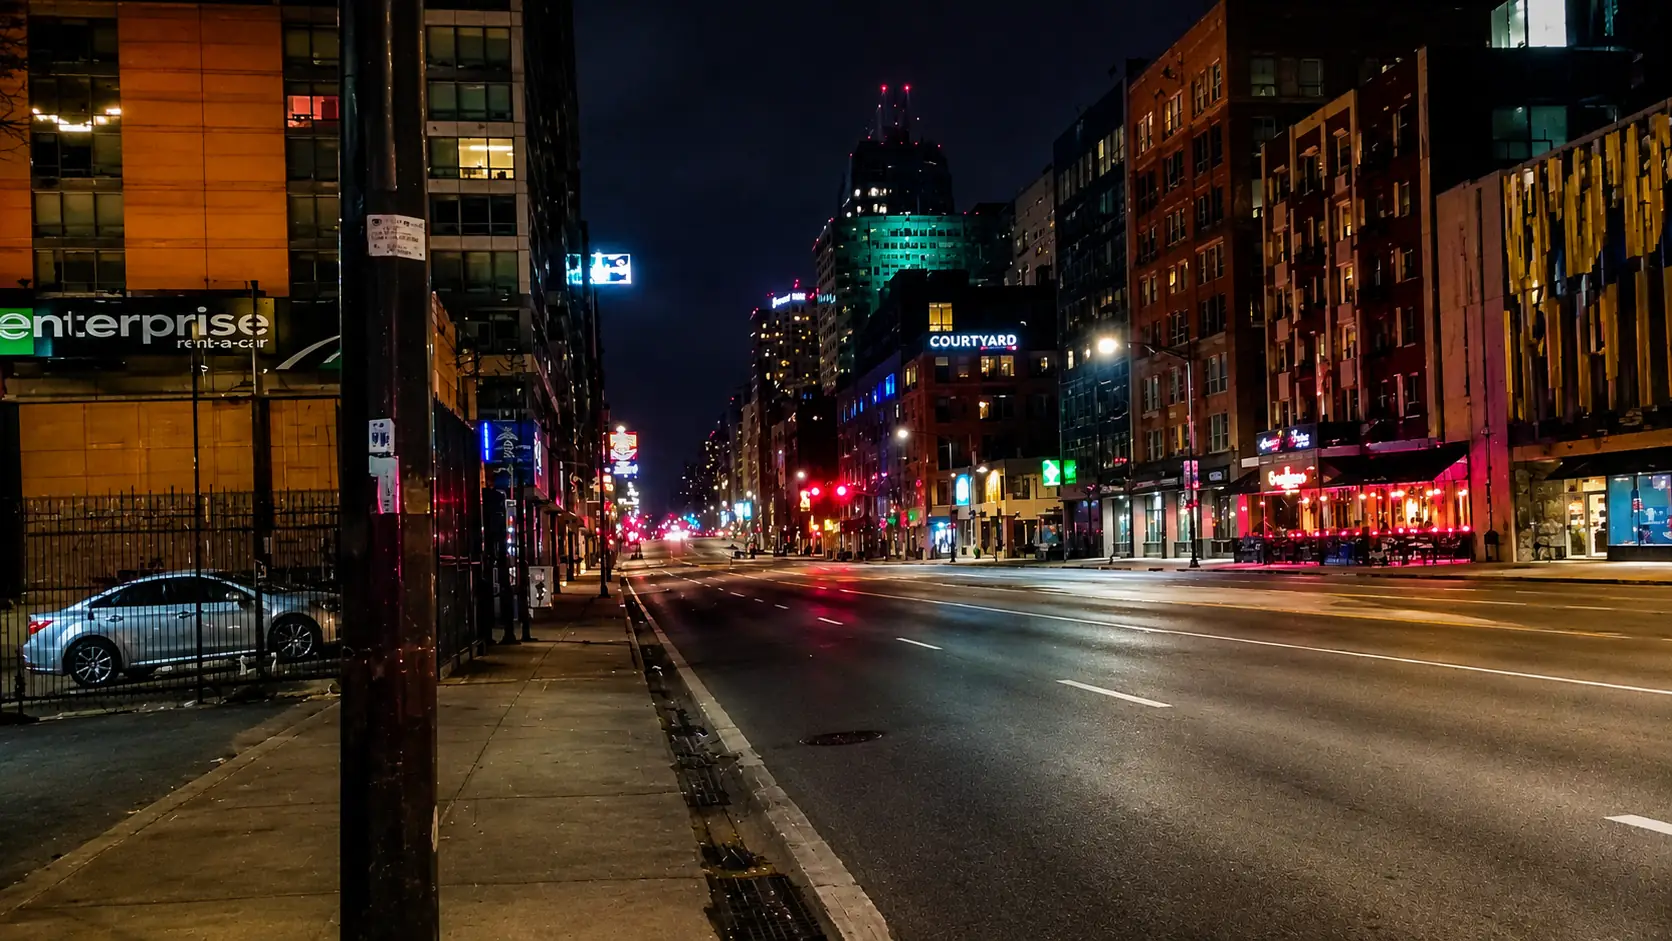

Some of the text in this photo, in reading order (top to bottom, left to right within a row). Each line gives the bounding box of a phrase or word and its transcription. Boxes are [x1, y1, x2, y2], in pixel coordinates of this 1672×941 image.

[0, 306, 269, 344] enterprise
[177, 337, 269, 348] rent-a-car
[930, 334, 1017, 347] COURTYARD
